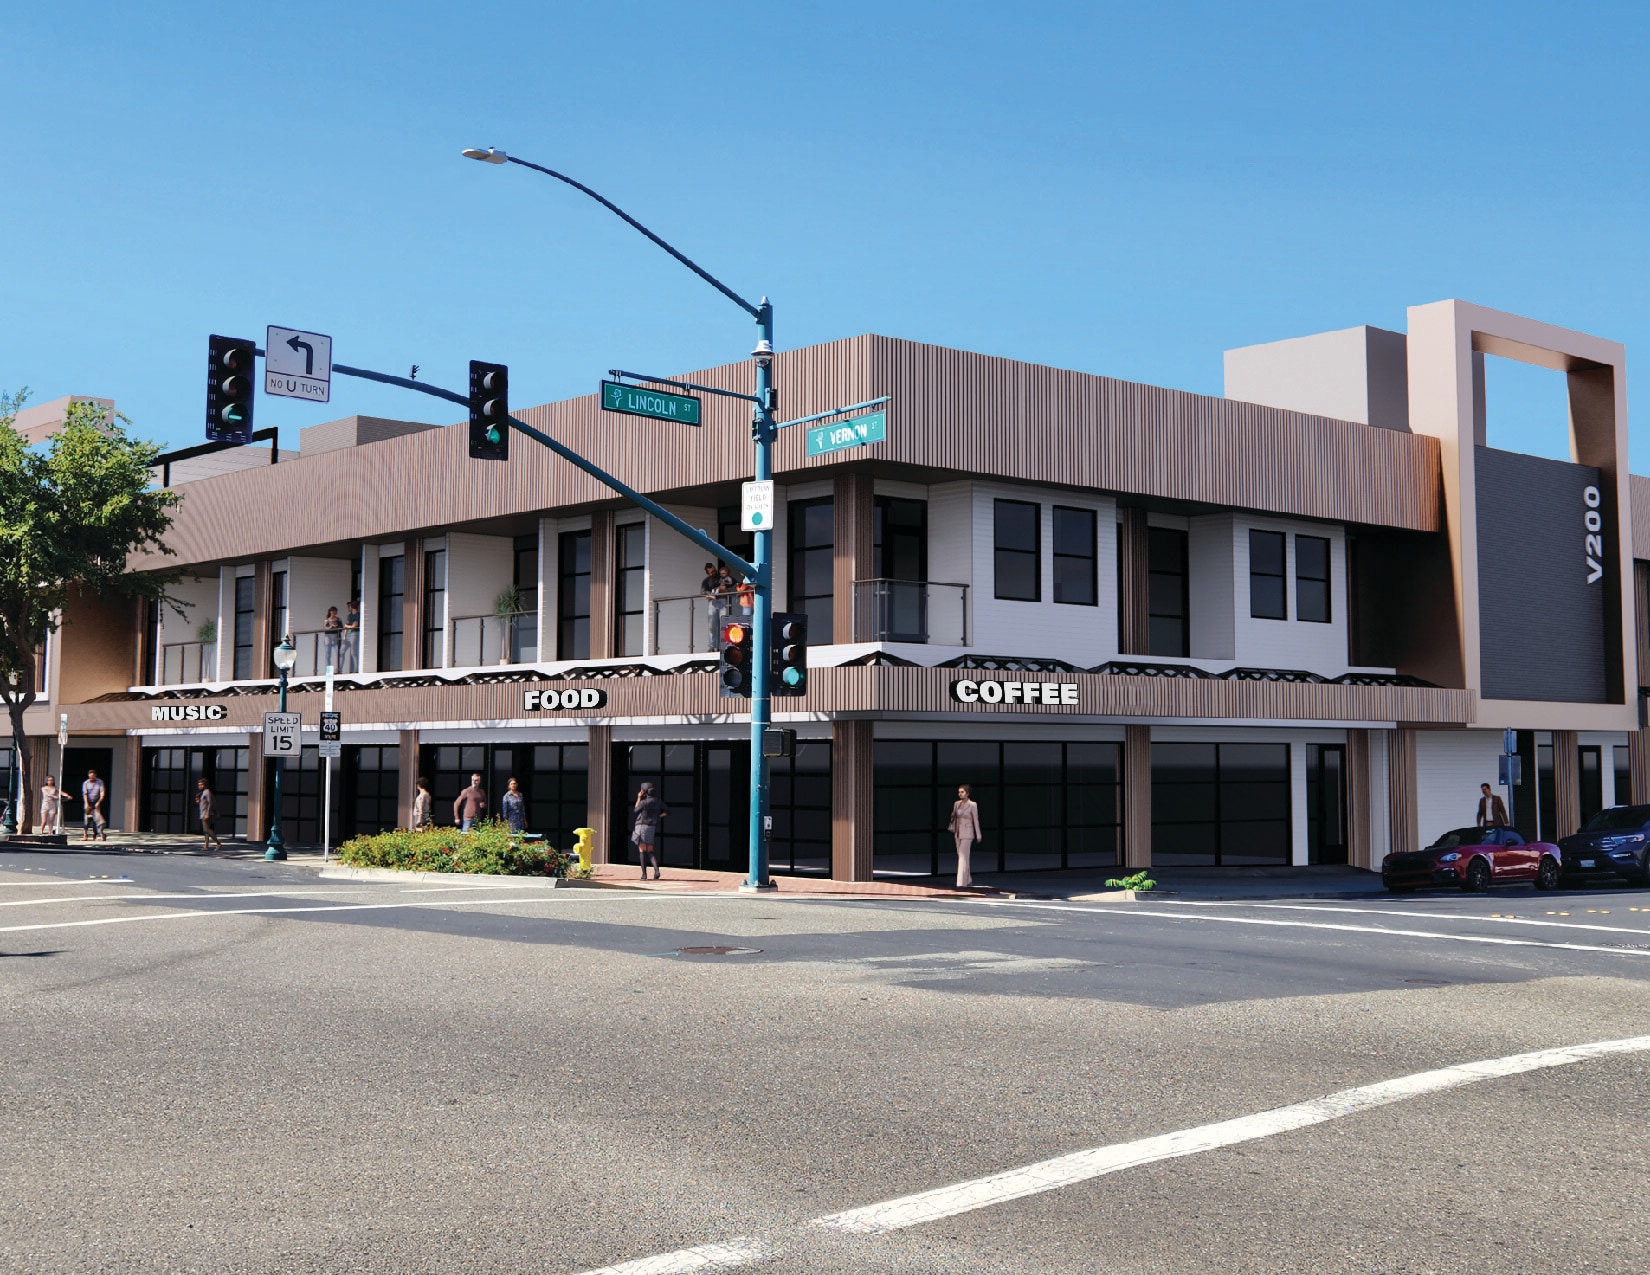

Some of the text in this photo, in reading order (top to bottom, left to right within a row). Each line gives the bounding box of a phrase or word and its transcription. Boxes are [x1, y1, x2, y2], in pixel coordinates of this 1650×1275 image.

[270, 379, 325, 396] NO U TURN
[628, 394, 691, 416] LINCOLN ST
[829, 423, 867, 445] VERNON
[1583, 486, 1602, 585] V200
[524, 688, 600, 710] FOOD
[956, 679, 1079, 705] COFFEE
[151, 705, 223, 720] MUSIC
[267, 717, 299, 725] SPEED
[273, 735, 292, 750] 15
